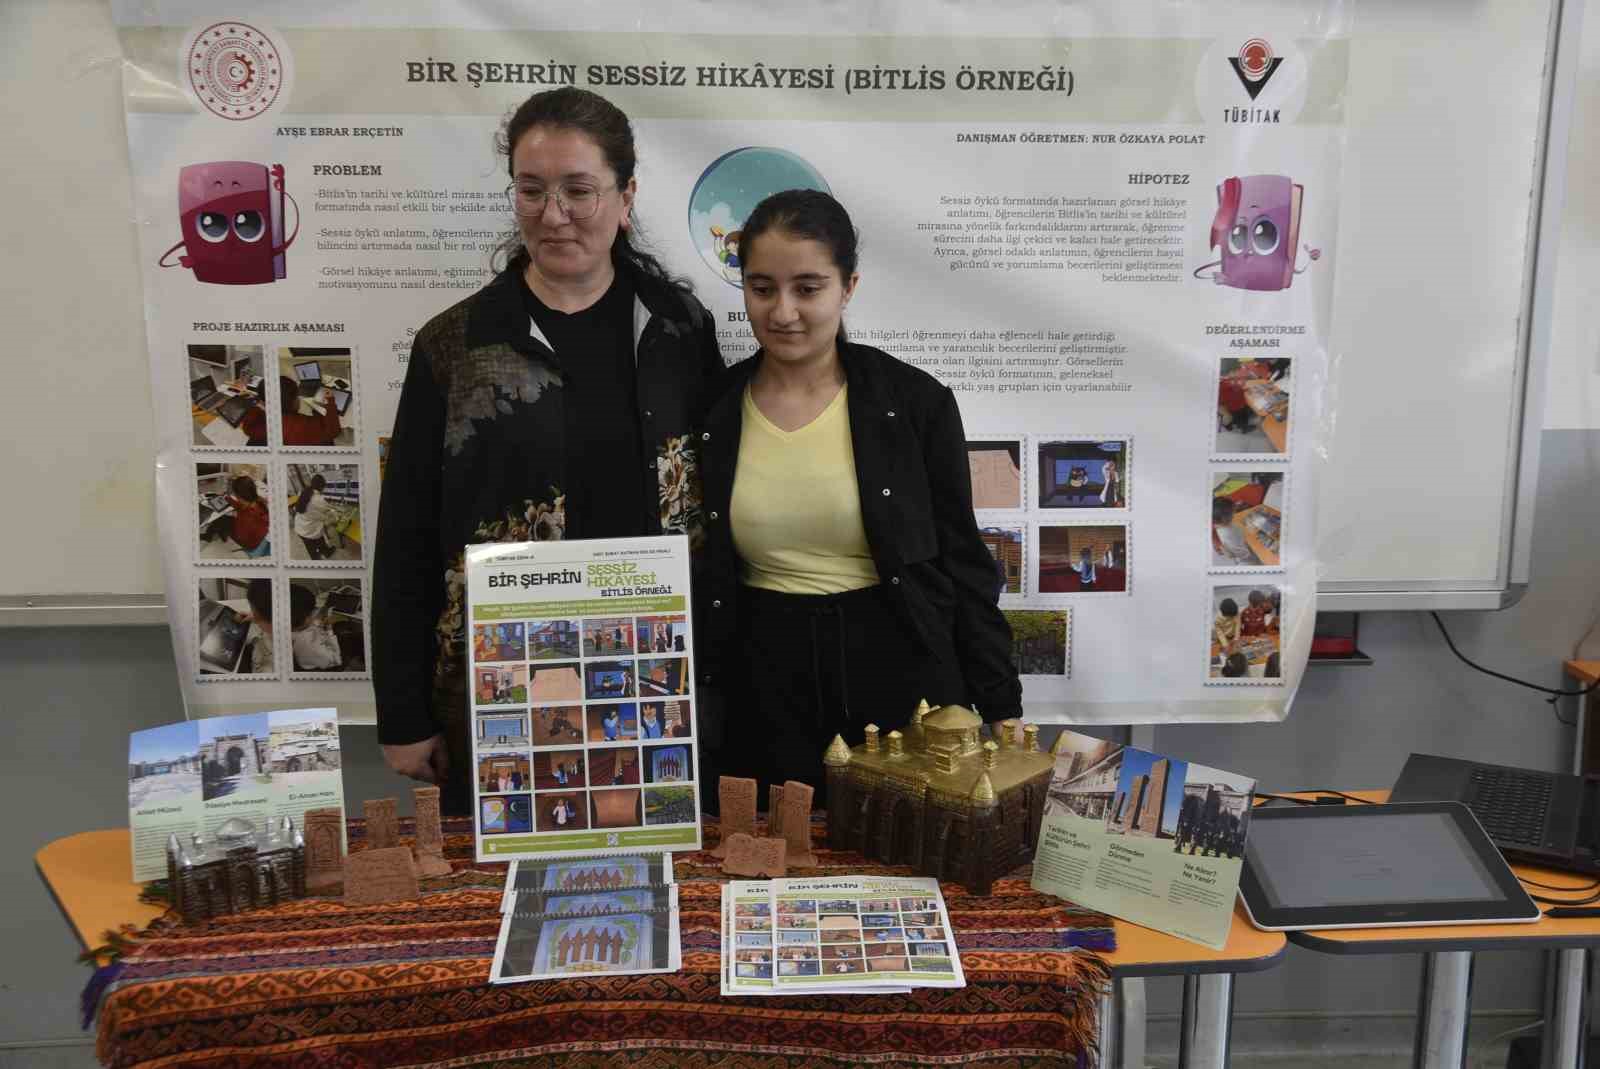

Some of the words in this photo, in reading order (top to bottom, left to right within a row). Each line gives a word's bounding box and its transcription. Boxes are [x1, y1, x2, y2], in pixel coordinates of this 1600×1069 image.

[406, 57, 458, 83] BİR
[466, 59, 576, 88] ŞEHRİN
[587, 61, 687, 87] SESSİZ
[696, 62, 835, 89] HİKÂYESİ
[844, 64, 946, 95] (BİTLİS
[955, 65, 1075, 96] ÖRNEĞİ)
[1223, 106, 1281, 123] TÜBİTAK
[276, 127, 307, 138] AYŞE
[310, 128, 350, 137] EBRAR
[353, 127, 404, 138] ERÇETİN
[956, 133, 1016, 145] DANIŞMAN
[1020, 132, 1089, 145] ÖĞRETMEN:
[1092, 134, 1116, 144] NUR
[1119, 133, 1165, 144] ÖZKAYA
[1168, 135, 1206, 145] POLAT
[313, 165, 383, 177] PROBLEM
[1127, 172, 1190, 185] HİPOTEZ
[391, 188, 402, 199] ve
[432, 201, 446, 212] bir
[444, 240, 459, 251] bir
[462, 240, 476, 251] rol
[192, 322, 231, 332] PROJE
[234, 322, 291, 333] HAZIRLIK
[293, 323, 345, 334] AŞAMASI
[1205, 324, 1306, 335] DEĞERLENDİRME
[1229, 338, 1281, 349] AŞAMASI
[488, 571, 518, 588] BİR
[520, 568, 582, 589] ŞEHRİN
[634, 583, 673, 596] ÖRNEĞİ
